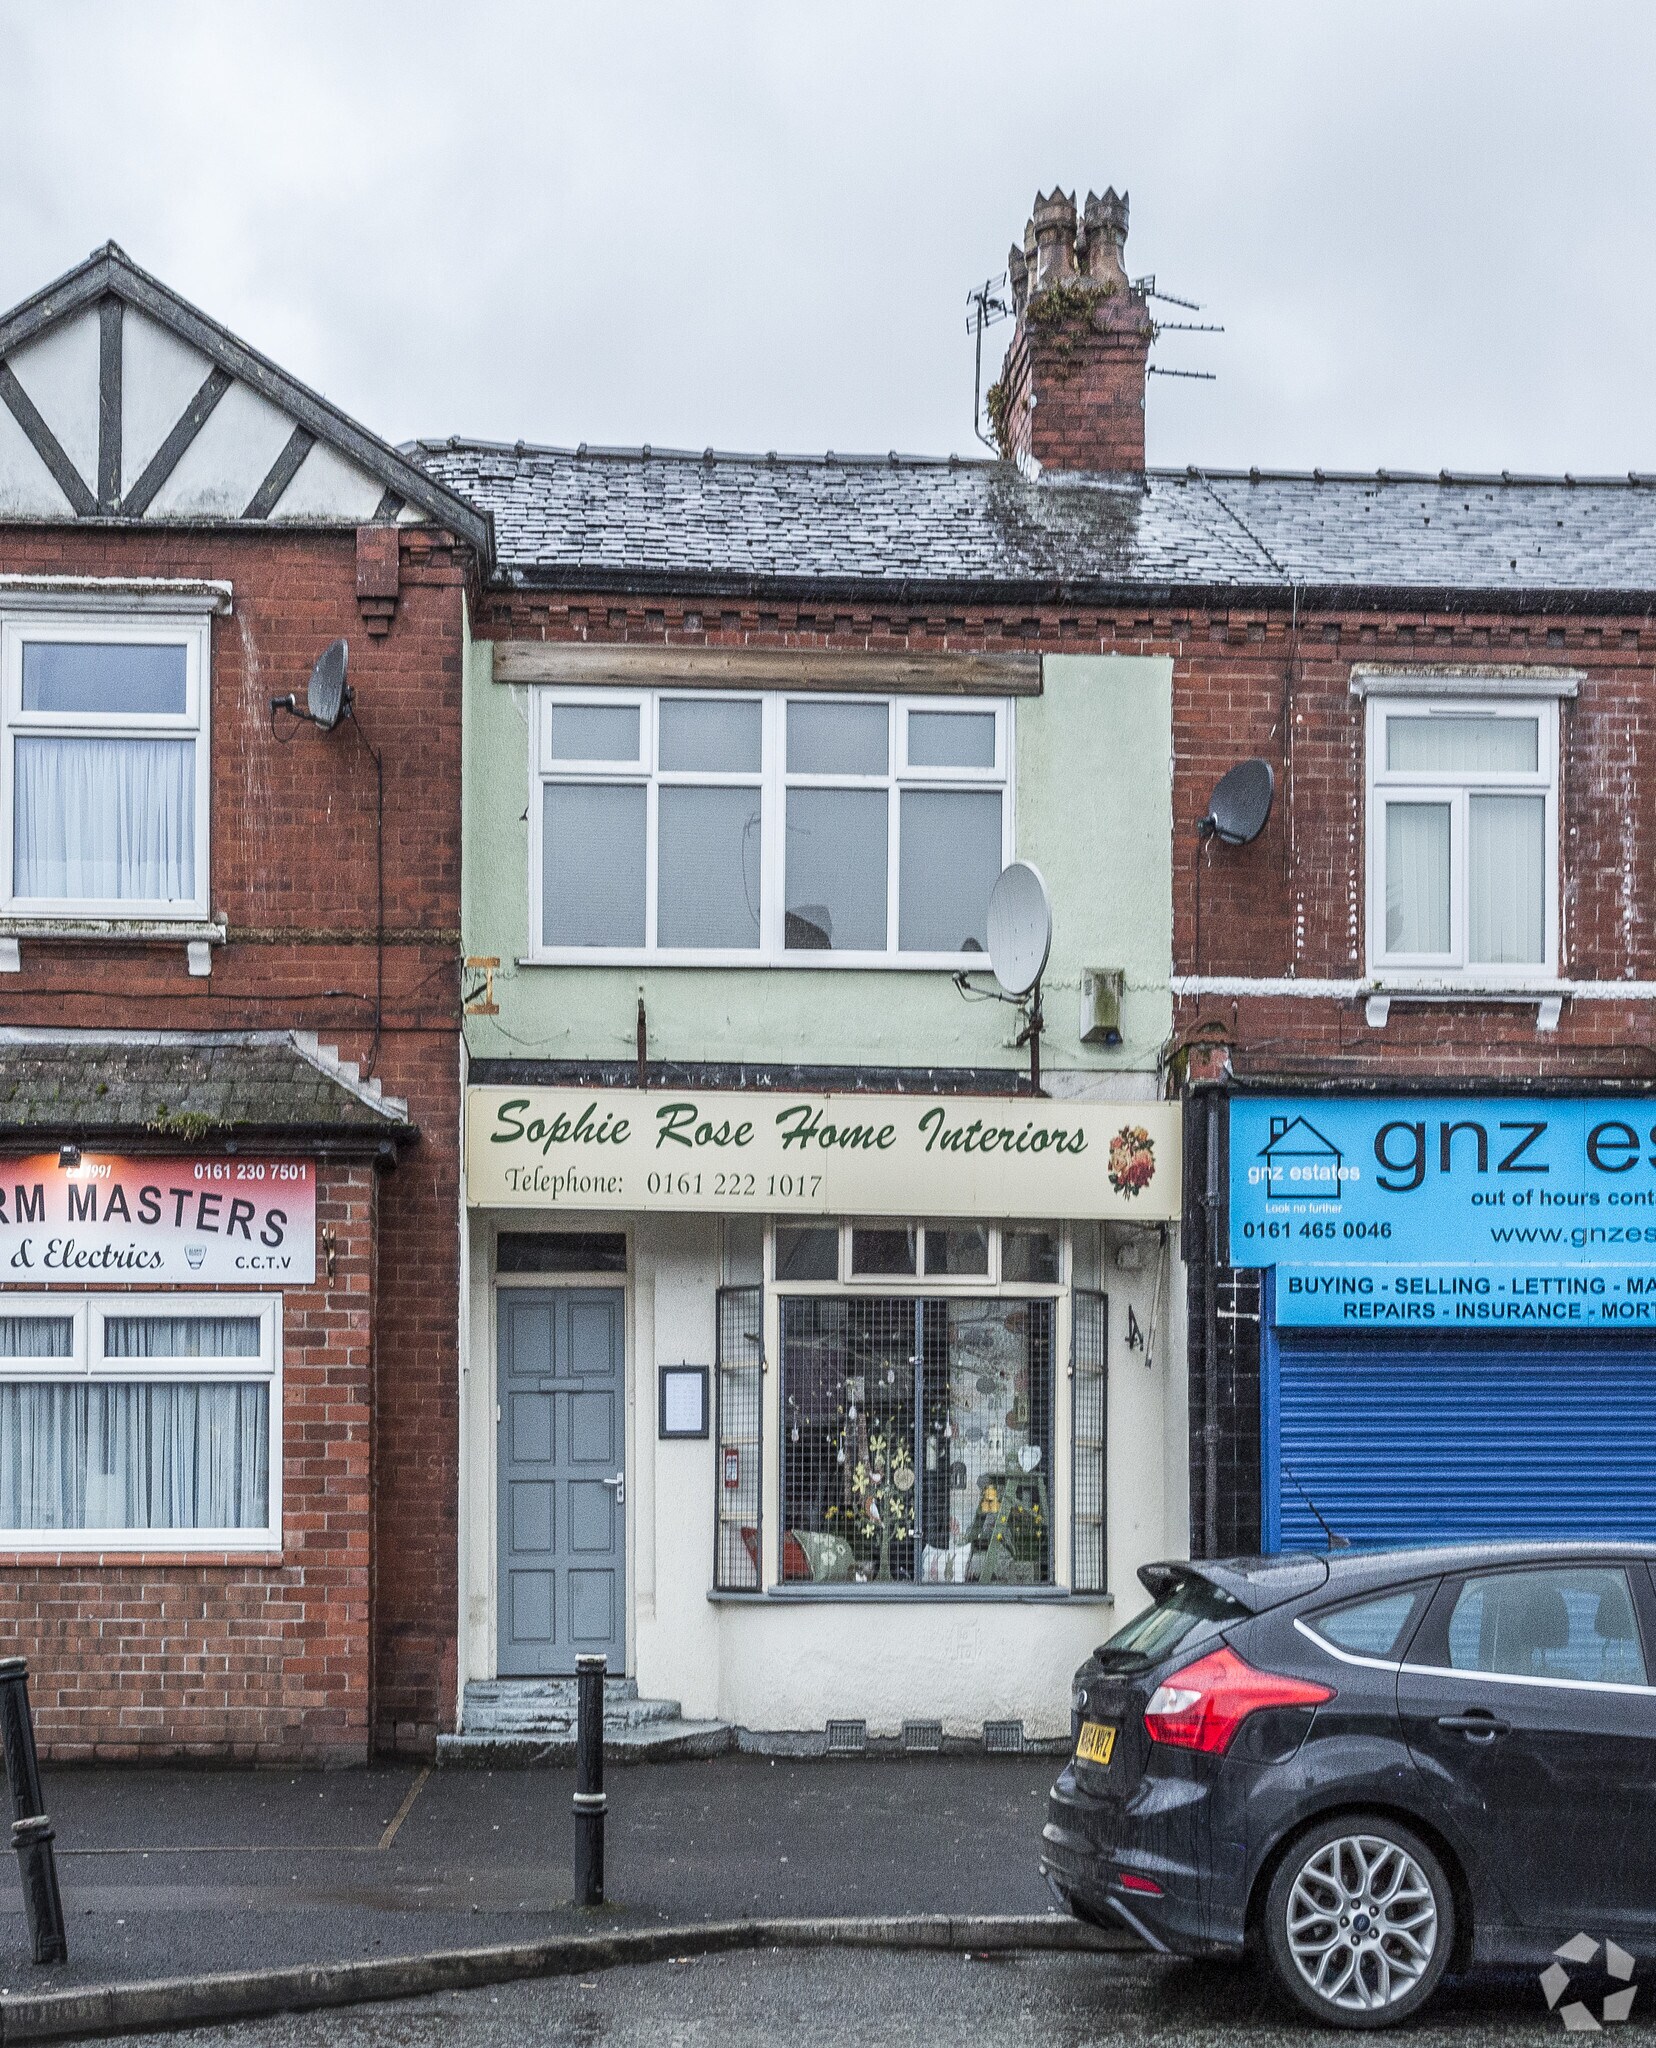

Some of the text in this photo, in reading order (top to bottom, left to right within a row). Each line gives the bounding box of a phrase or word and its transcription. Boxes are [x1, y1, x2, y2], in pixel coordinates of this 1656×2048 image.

[491, 1099, 1088, 1155] Sophie Rose Home Interiors
[1374, 1120, 1656, 1192] gnz e
[194, 1164, 307, 1180] 0161 230 7501
[1248, 1163, 1360, 1184] gnz estates
[504, 1166, 822, 1200] Telephone: 0161 222 1017
[1471, 1188, 1656, 1206] out of hours cont
[67, 1183, 288, 1248] MASTERS
[1265, 1203, 1343, 1214] Look no further
[1243, 1221, 1392, 1239] 0161 465 0046
[43, 1239, 165, 1269] Electrics
[235, 1256, 292, 1270] C.C.T.V
[1288, 1276, 1374, 1294] BUYING
[1395, 1276, 1491, 1295] SELLING
[1512, 1277, 1606, 1295] LETTING
[1343, 1302, 1436, 1319] REPAIRS
[1456, 1302, 1581, 1319] INSURANCE
